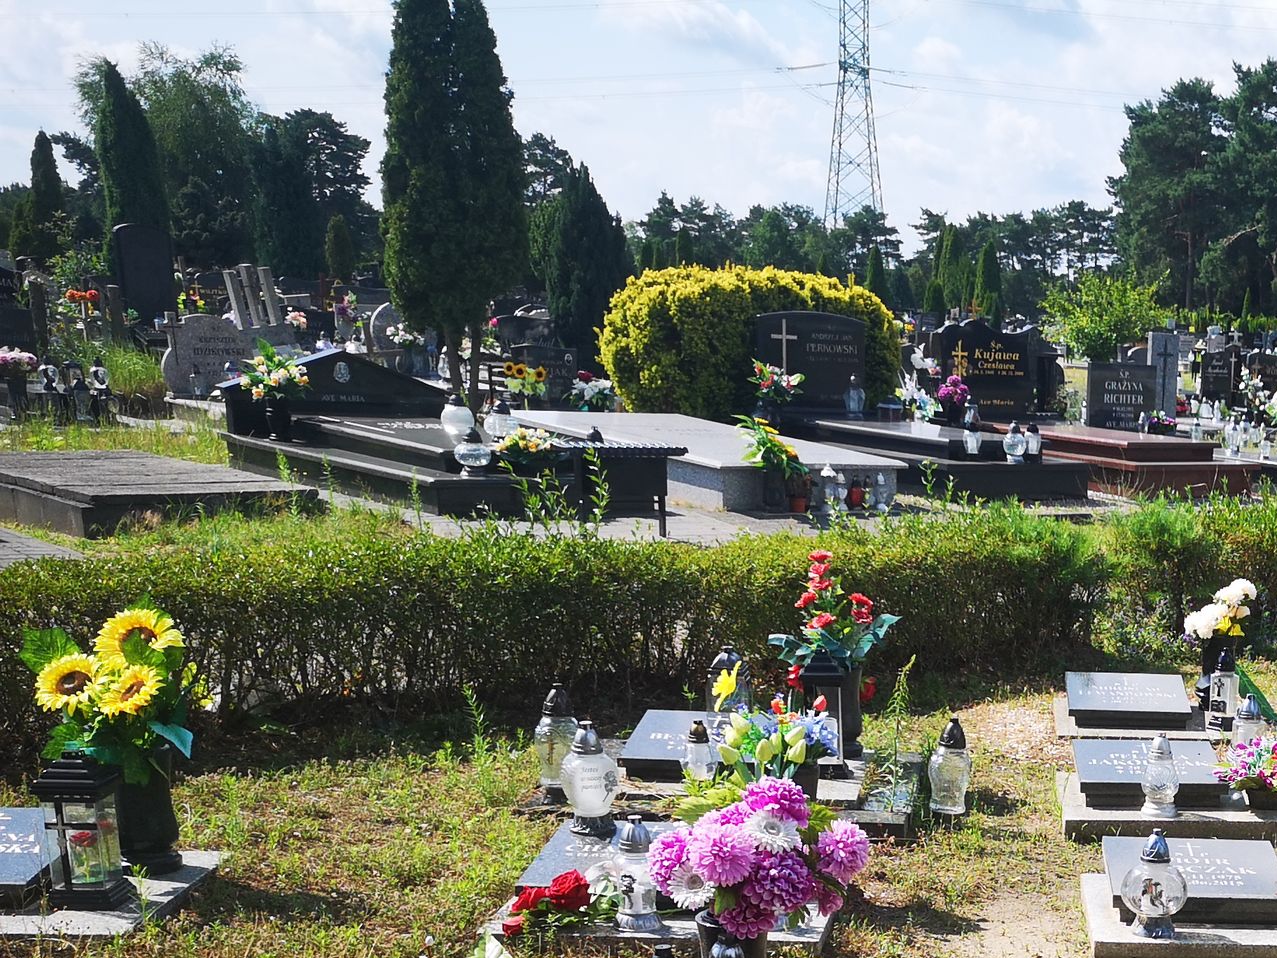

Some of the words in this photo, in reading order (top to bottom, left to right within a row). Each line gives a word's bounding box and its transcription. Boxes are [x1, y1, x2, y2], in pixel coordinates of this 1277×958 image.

[974, 348, 1020, 361] Kujawa
[1105, 380, 1143, 391] GRAŻYNA
[1104, 393, 1144, 405] RICHTER
